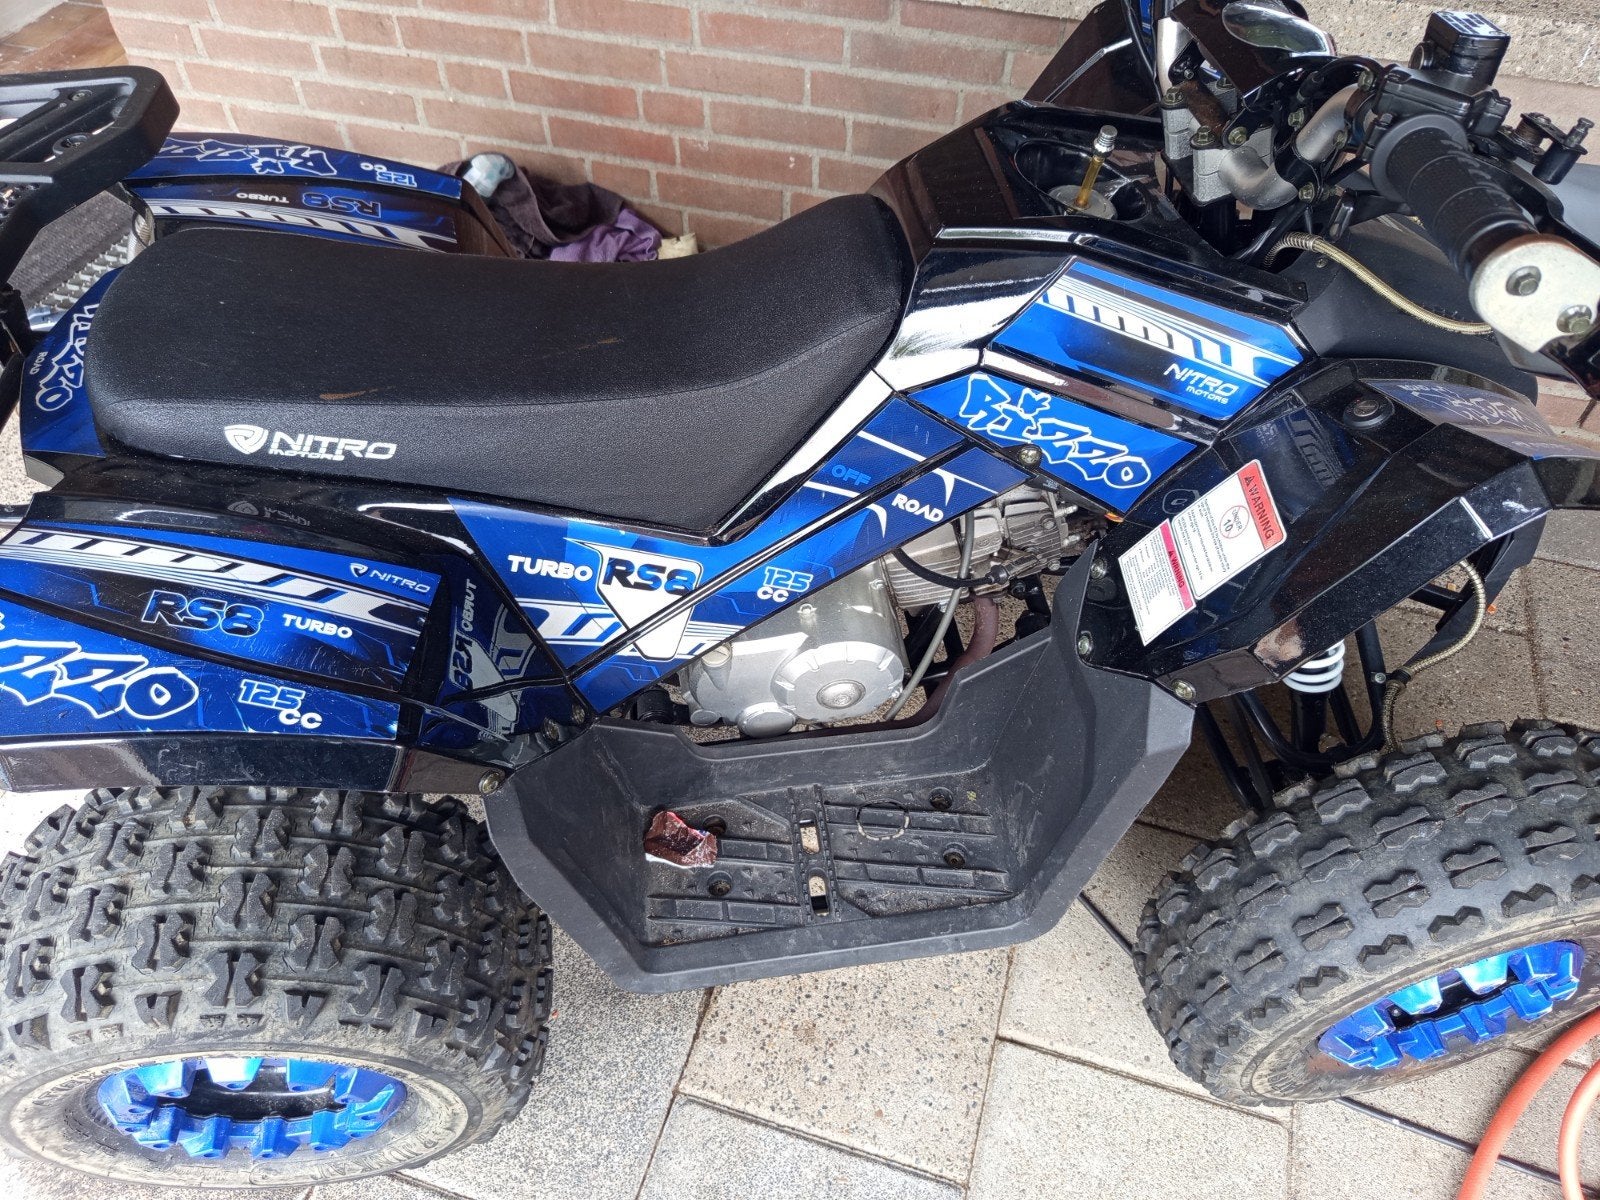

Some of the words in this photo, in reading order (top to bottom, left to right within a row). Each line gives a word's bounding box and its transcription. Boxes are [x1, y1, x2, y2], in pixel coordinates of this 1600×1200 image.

[376, 171, 417, 187] 125
[237, 193, 289, 204] TURBO
[302, 192, 381, 218] RS8
[30, 351, 48, 375] ROAD
[1163, 363, 1239, 397] NITRO
[1186, 385, 1229, 404] MOTORS
[269, 431, 397, 459] NITRO
[831, 464, 871, 485] OFF
[891, 493, 944, 522] ROAD
[1249, 484, 1274, 539] WARNING
[1223, 519, 1233, 532] 10
[369, 569, 431, 593] NITRO
[507, 554, 593, 581] TURBO
[602, 557, 696, 596] RS8
[763, 566, 814, 592] 125
[757, 586, 789, 602] CC
[141, 589, 264, 637] RS8
[283, 613, 353, 638] TURBO
[238, 679, 306, 711] 125
[278, 708, 322, 729] CC
